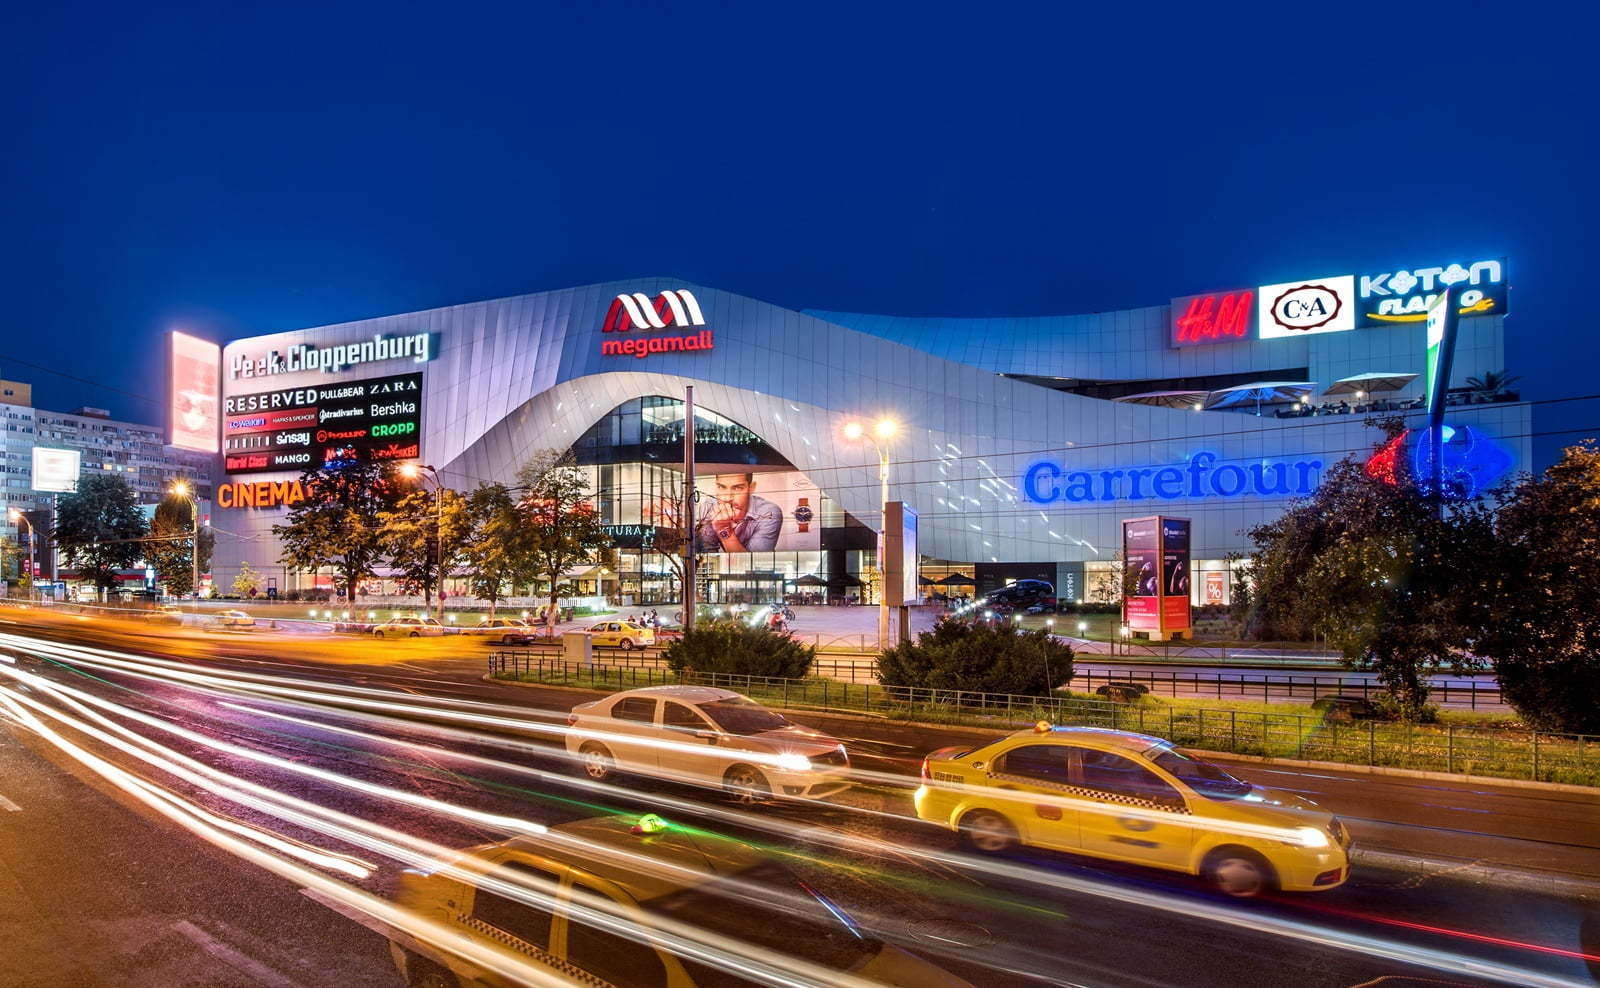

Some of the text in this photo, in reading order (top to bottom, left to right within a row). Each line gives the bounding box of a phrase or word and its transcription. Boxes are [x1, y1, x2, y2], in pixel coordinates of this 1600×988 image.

[1283, 296, 1327, 319] C&A
[1378, 289, 1484, 315] FLAO
[1177, 291, 1253, 342] H&M
[602, 331, 714, 358] megamall
[320, 386, 364, 400] PULL&BEAR
[370, 381, 417, 394] ZARA
[226, 390, 318, 412] RESERVED
[370, 401, 415, 417] Bershka
[276, 432, 310, 446] sinsay
[371, 422, 415, 437] CROPP
[275, 454, 311, 465] MANGO
[1024, 452, 1322, 503] Carrefour
[217, 480, 304, 508] CINEMA
